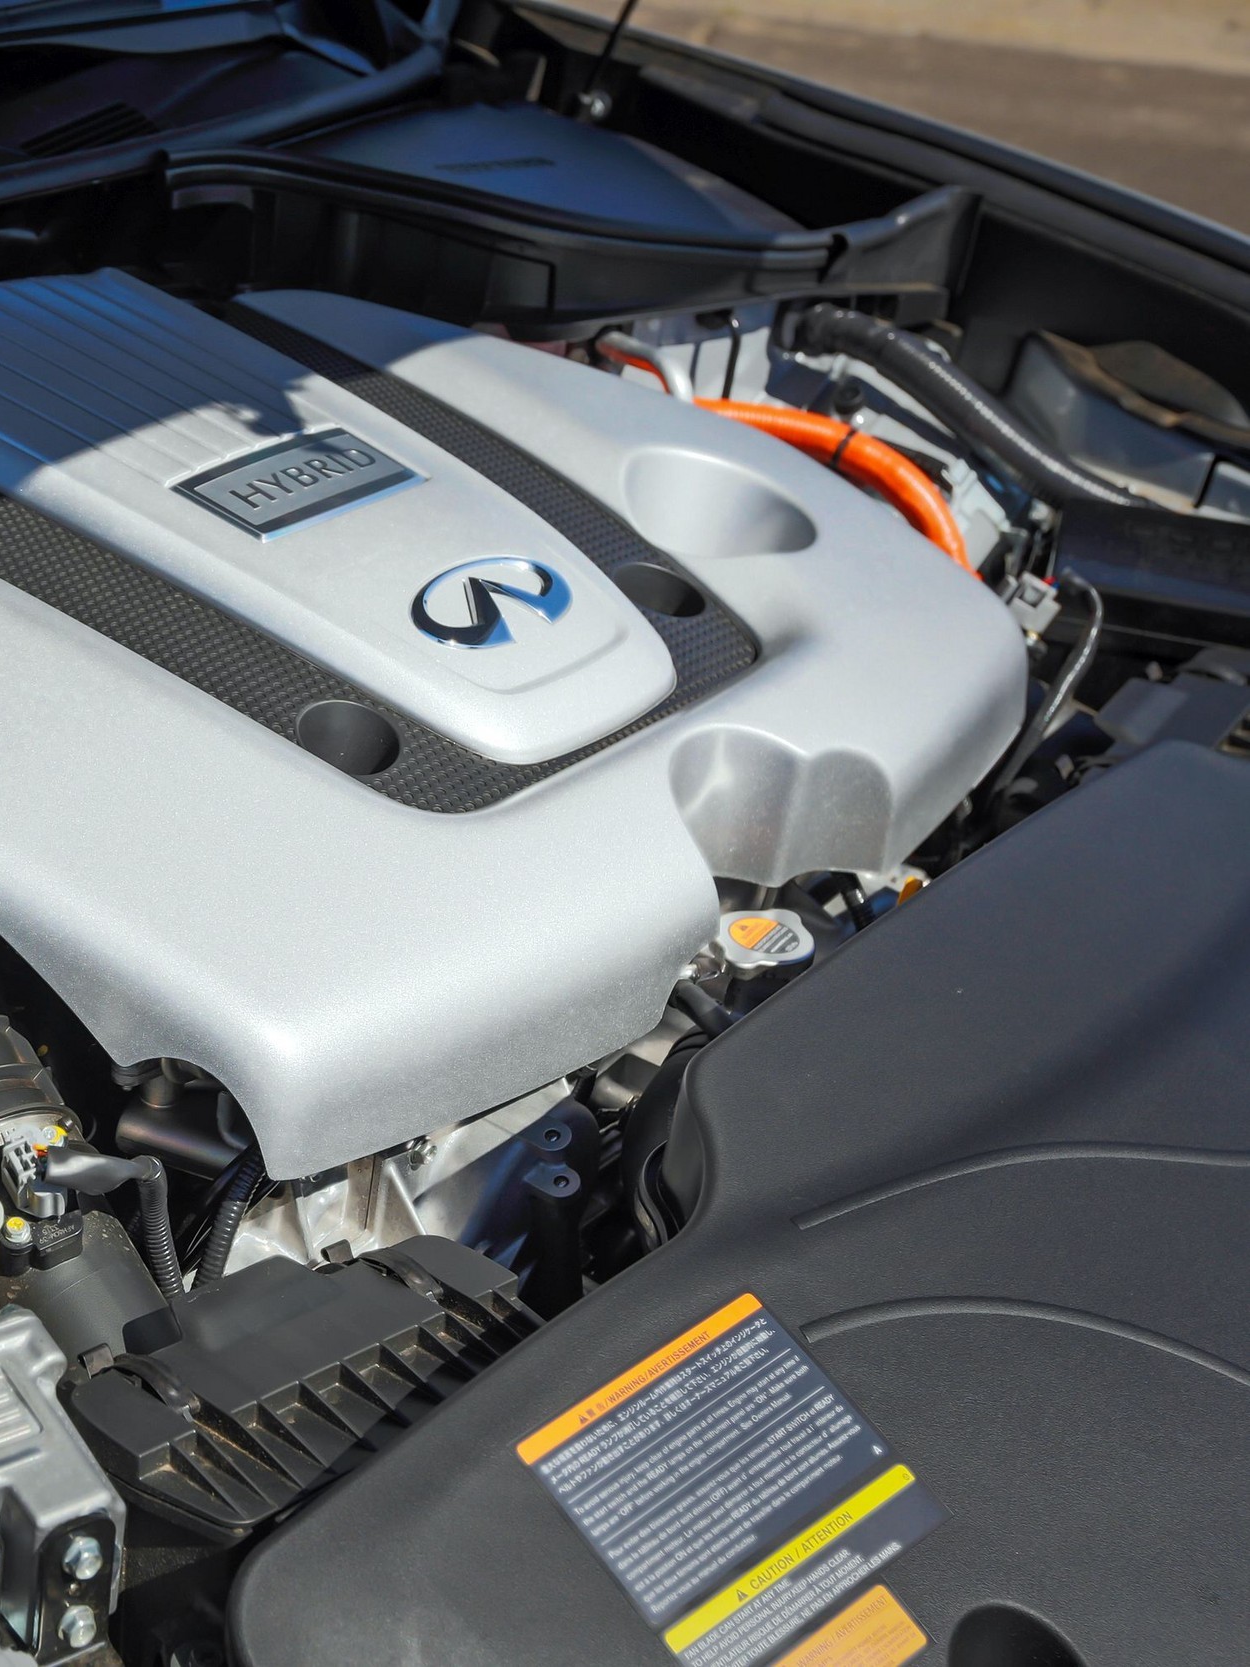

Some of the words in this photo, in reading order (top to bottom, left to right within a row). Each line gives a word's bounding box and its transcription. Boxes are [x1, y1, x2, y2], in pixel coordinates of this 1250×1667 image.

[229, 447, 378, 511] HYBRID
[727, 1393, 747, 1407] Engine
[767, 1427, 787, 1444] START
[785, 1411, 810, 1431] SWITCH
[813, 1393, 835, 1410] READY
[578, 1445, 602, 1464] READY
[871, 1444, 882, 1454] A
[646, 1462, 669, 1480] READY
[730, 1502, 752, 1520] READY
[748, 1553, 794, 1590] CAUTION
[799, 1511, 852, 1552] ATTENTION
[831, 1564, 870, 1595] APPROCHER
[700, 1645, 720, 1661] HELP
[717, 1631, 739, 1649] AVOID
[737, 1606, 772, 1634] PERSONAL
[805, 1564, 830, 1583] HANDS
[747, 1621, 774, 1642] RISQUE
[771, 1614, 783, 1625] DE
[818, 1574, 837, 1590] TOUT
[834, 1596, 888, 1639] AVERTISSEMENT
